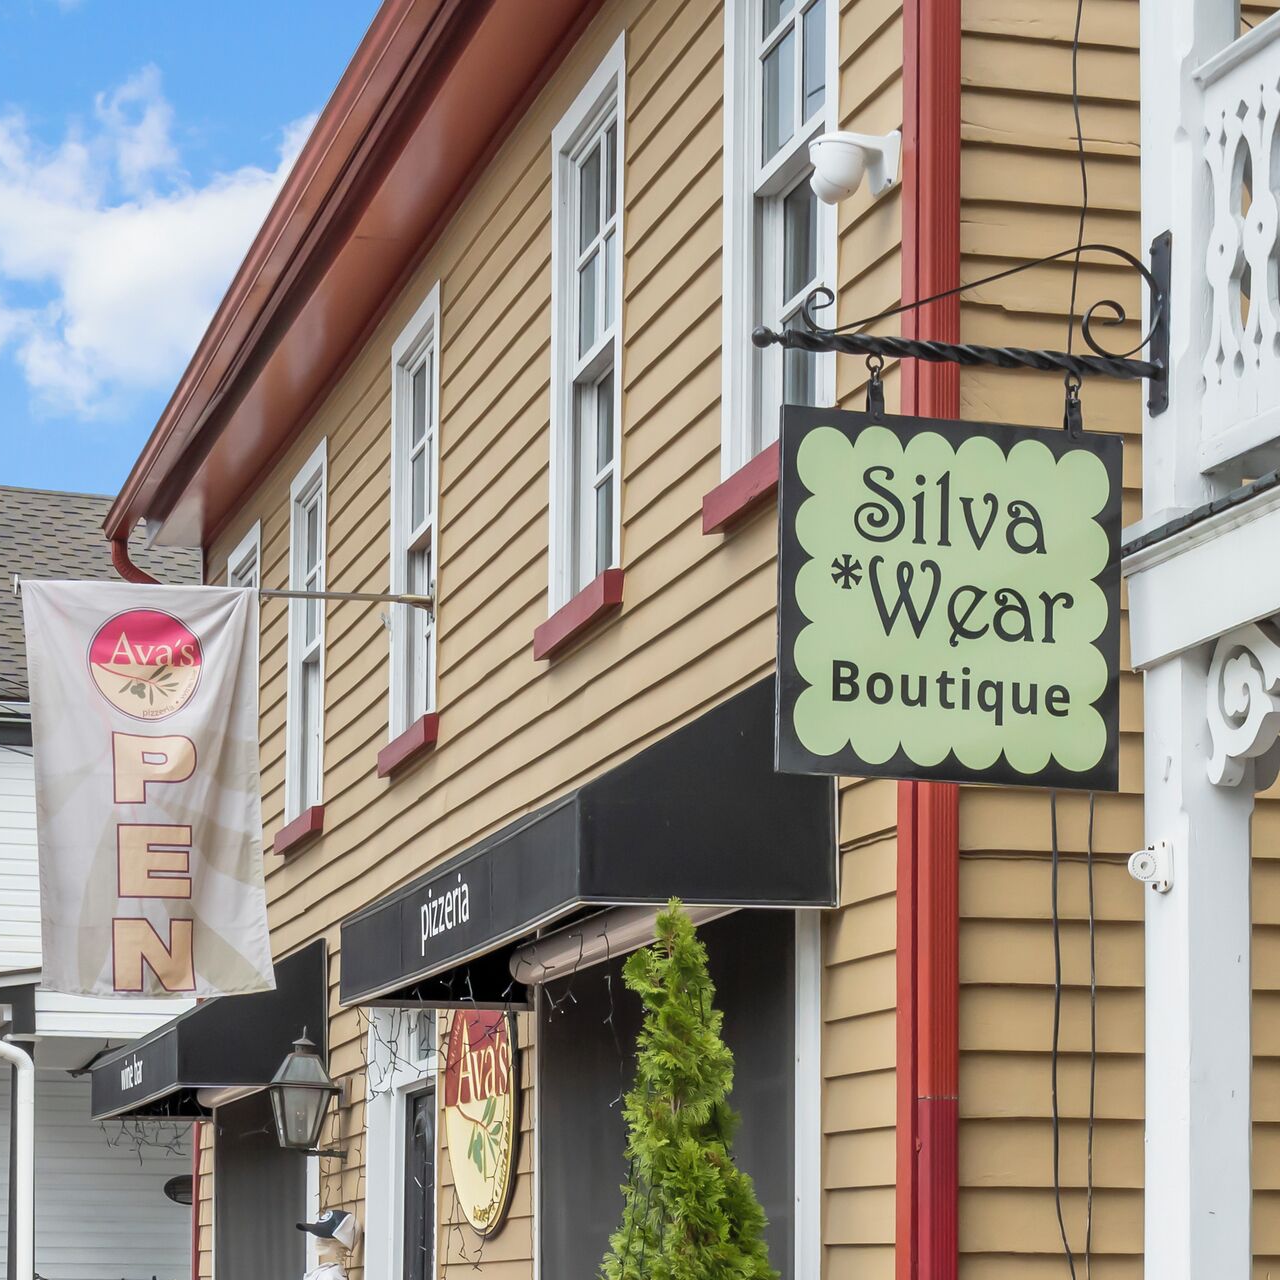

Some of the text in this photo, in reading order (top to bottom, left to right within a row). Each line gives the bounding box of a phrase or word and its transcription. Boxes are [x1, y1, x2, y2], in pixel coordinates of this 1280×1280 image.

[854, 465, 1047, 555] Silva
[109, 631, 195, 667] Ava's
[831, 659, 1071, 727] Boutique
[420, 872, 470, 957] pizzeria
[456, 1017, 508, 1105] Ava's
